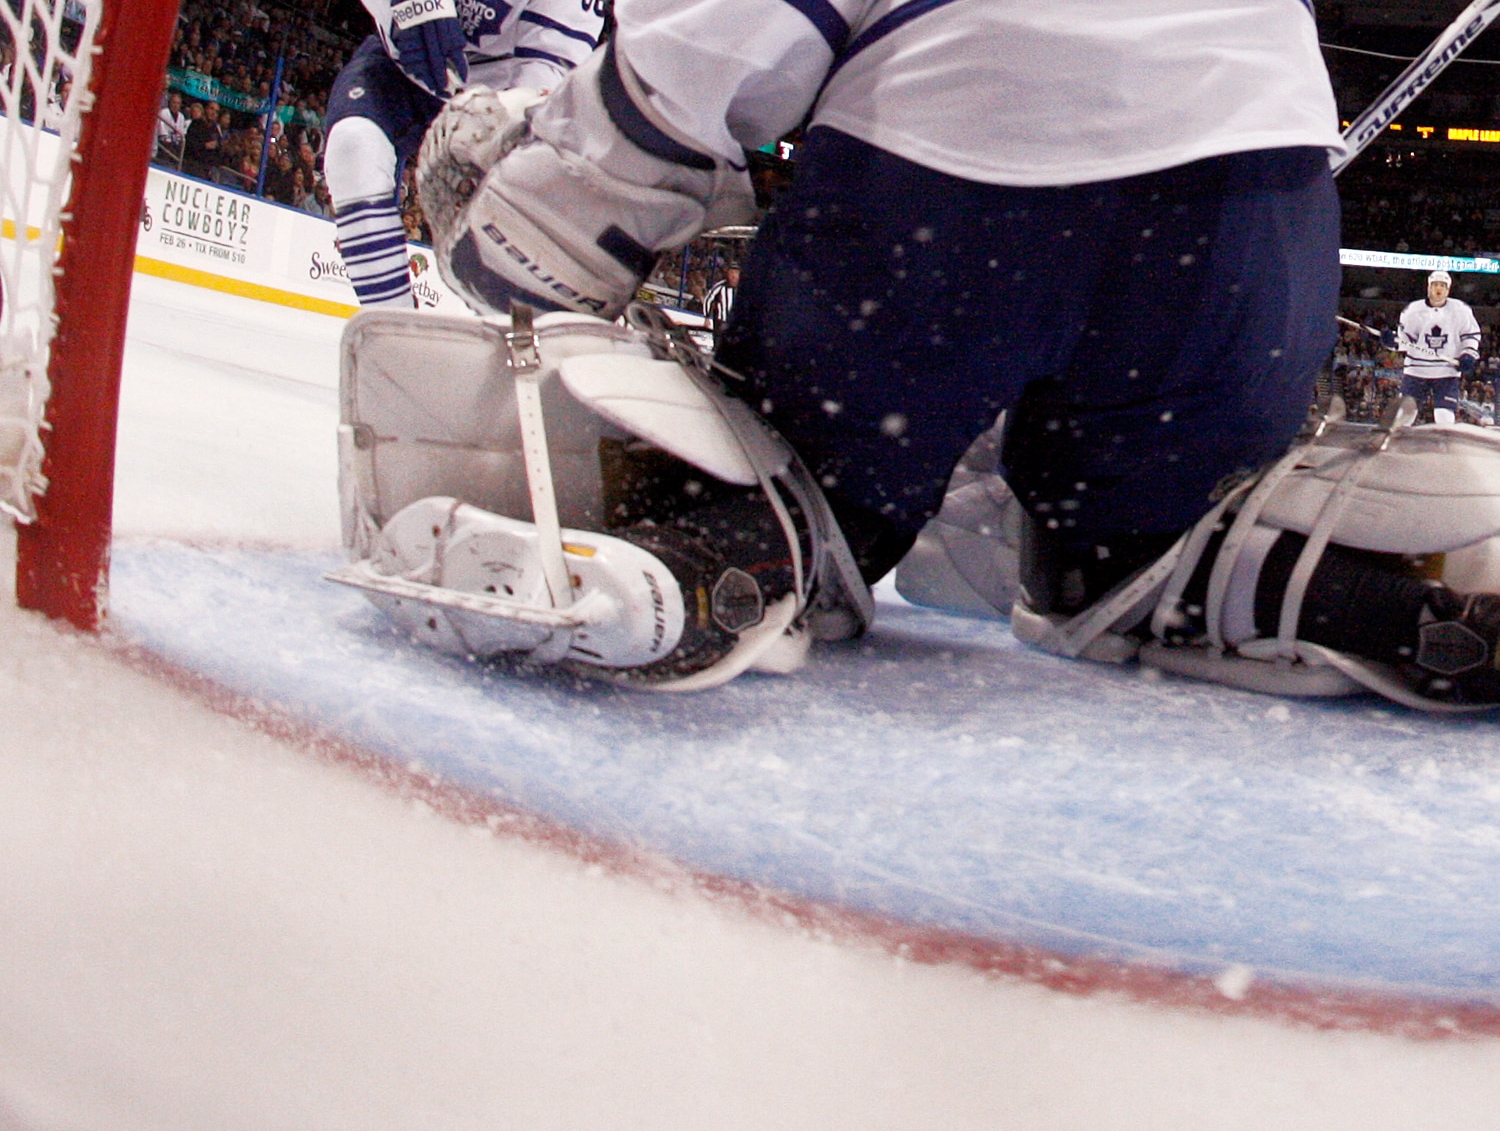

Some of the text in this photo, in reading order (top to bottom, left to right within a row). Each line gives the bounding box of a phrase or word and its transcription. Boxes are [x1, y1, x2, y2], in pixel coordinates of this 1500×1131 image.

[1448, 128, 1479, 142] MAPLE
[165, 179, 251, 223] NUCLEAR
[162, 203, 249, 245] COWBOYZ
[159, 232, 174, 245] FEB
[176, 237, 187, 249] 26
[195, 241, 208, 255] TIX
[208, 245, 231, 261] FROM
[1392, 256, 1405, 265] the
[1407, 256, 1435, 267] official
[1436, 258, 1455, 269] post
[1456, 260, 1478, 270] game
[309, 251, 350, 280] Swee
[481, 222, 607, 312] BAUER
[641, 569, 666, 653] BAUER
